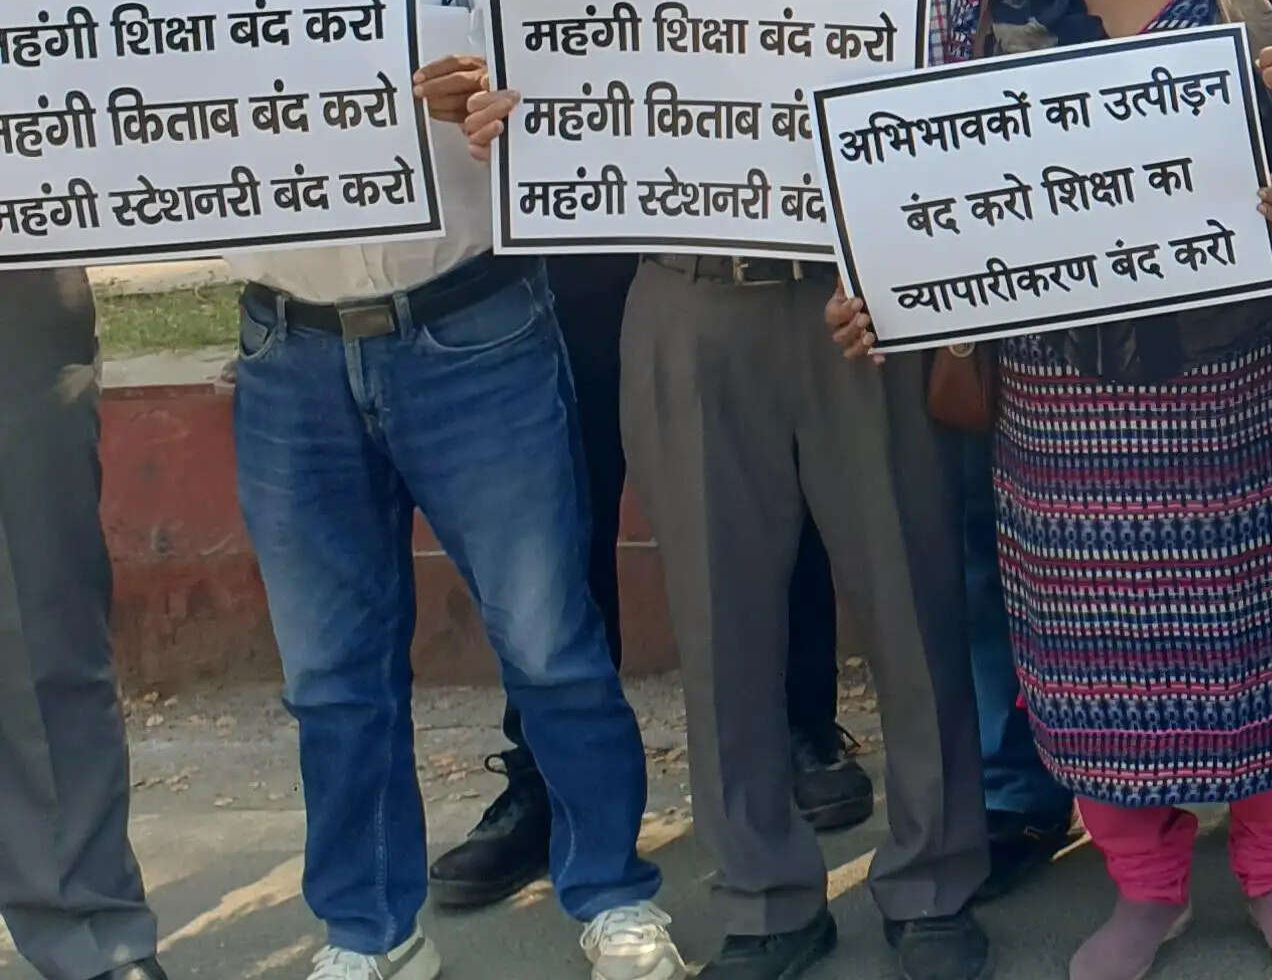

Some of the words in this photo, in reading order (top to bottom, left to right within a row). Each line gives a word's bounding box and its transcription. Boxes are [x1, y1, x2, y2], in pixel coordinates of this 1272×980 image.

[109, 2, 217, 57] शिक्षा
[521, 1, 643, 56] महंगी
[652, 1, 749, 54] शिक्षा
[758, 7, 816, 57] बंद
[824, 11, 898, 62] करो
[838, 90, 1032, 165] अभिभावकों
[1039, 91, 1091, 132] का
[1098, 66, 1231, 121] उत्पीड़न
[900, 192, 961, 238] बंद
[964, 173, 1033, 227] करो
[1040, 165, 1135, 216] शिक्षा
[1141, 157, 1193, 196] का
[890, 254, 1099, 313] व्यापारीकरण
[1105, 238, 1165, 282] बंद
[1167, 218, 1236, 272] करो
